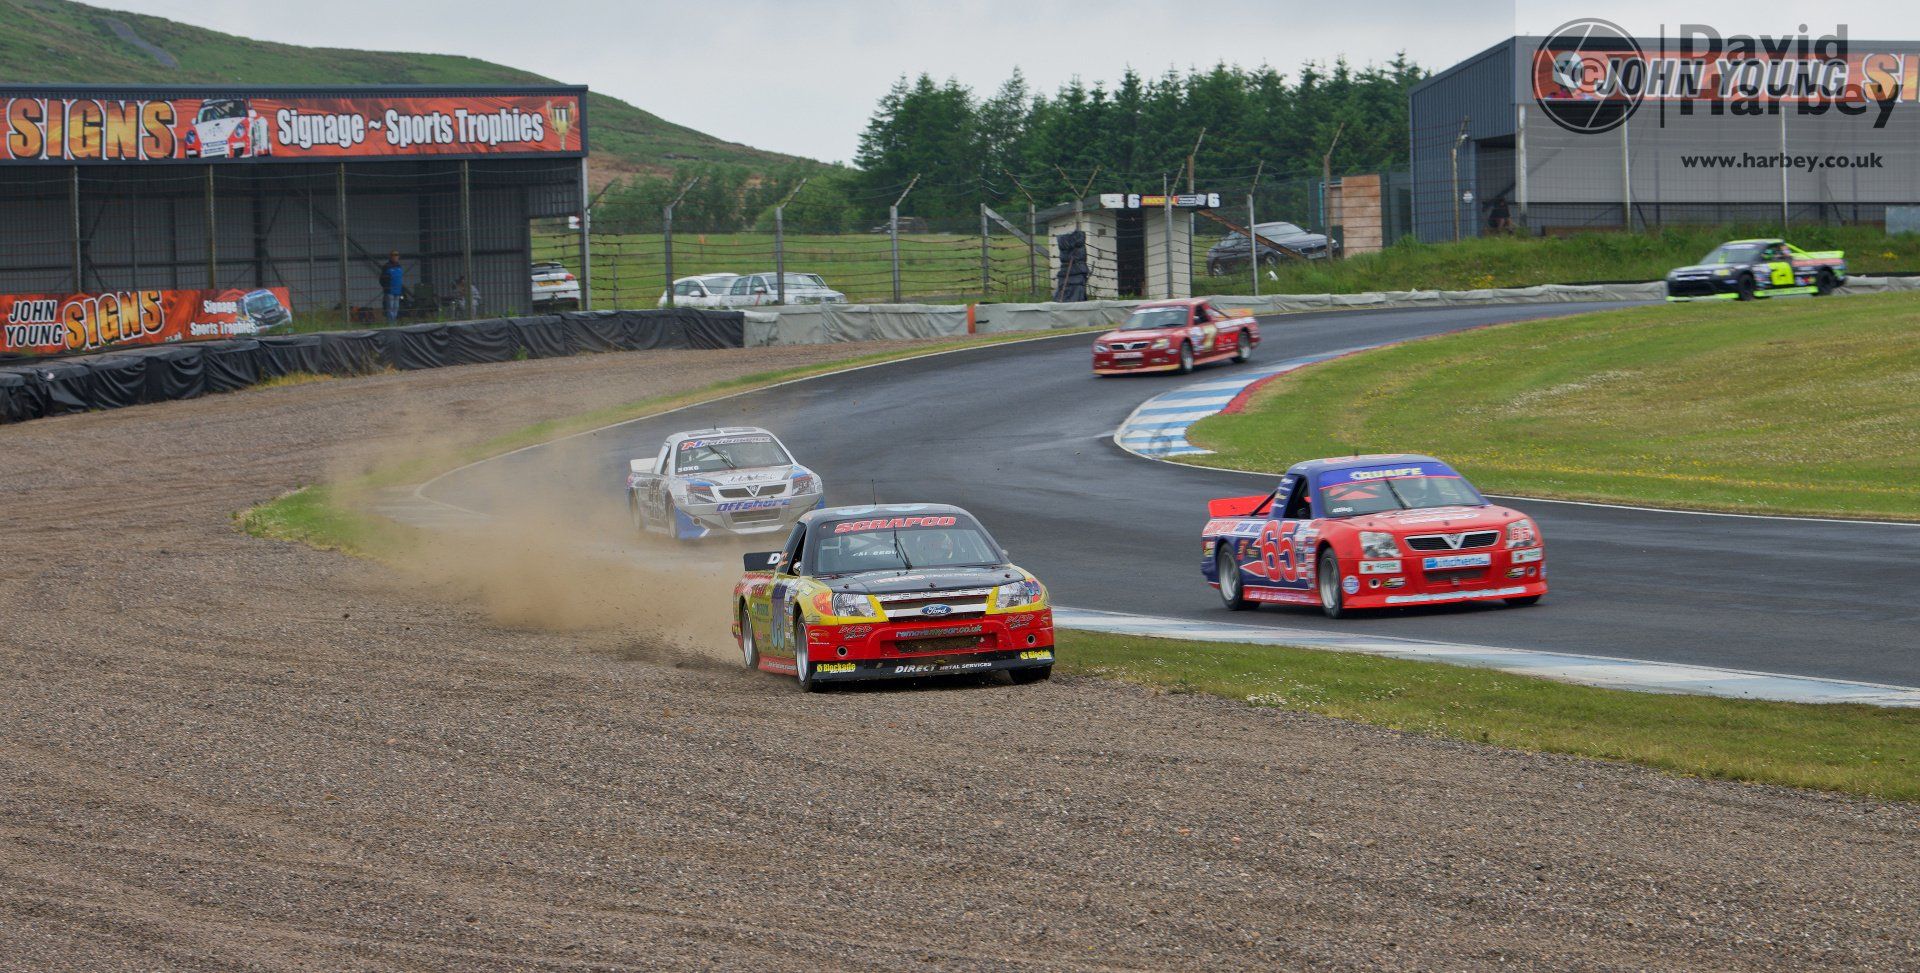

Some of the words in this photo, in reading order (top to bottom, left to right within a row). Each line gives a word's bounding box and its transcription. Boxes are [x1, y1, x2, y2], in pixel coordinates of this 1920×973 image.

[1595, 57, 1706, 97] JOHN
[1717, 58, 1849, 98] YOUNG
[7, 97, 177, 159] SIGNS
[277, 109, 365, 149] Signage
[385, 108, 453, 148] Sports
[454, 107, 544, 146] Trophies
[10, 300, 57, 324] JOHN
[203, 300, 238, 314] Signage
[62, 289, 164, 351] SIGNS
[190, 322, 218, 336] Sports
[219, 321, 258, 336] Trophies
[5, 324, 63, 347] YOUNG
[1350, 468, 1421, 480] QUAIFE
[1261, 519, 1300, 582] 65
[925, 605, 948, 615] Ford
[895, 664, 936, 674] DIRECT
